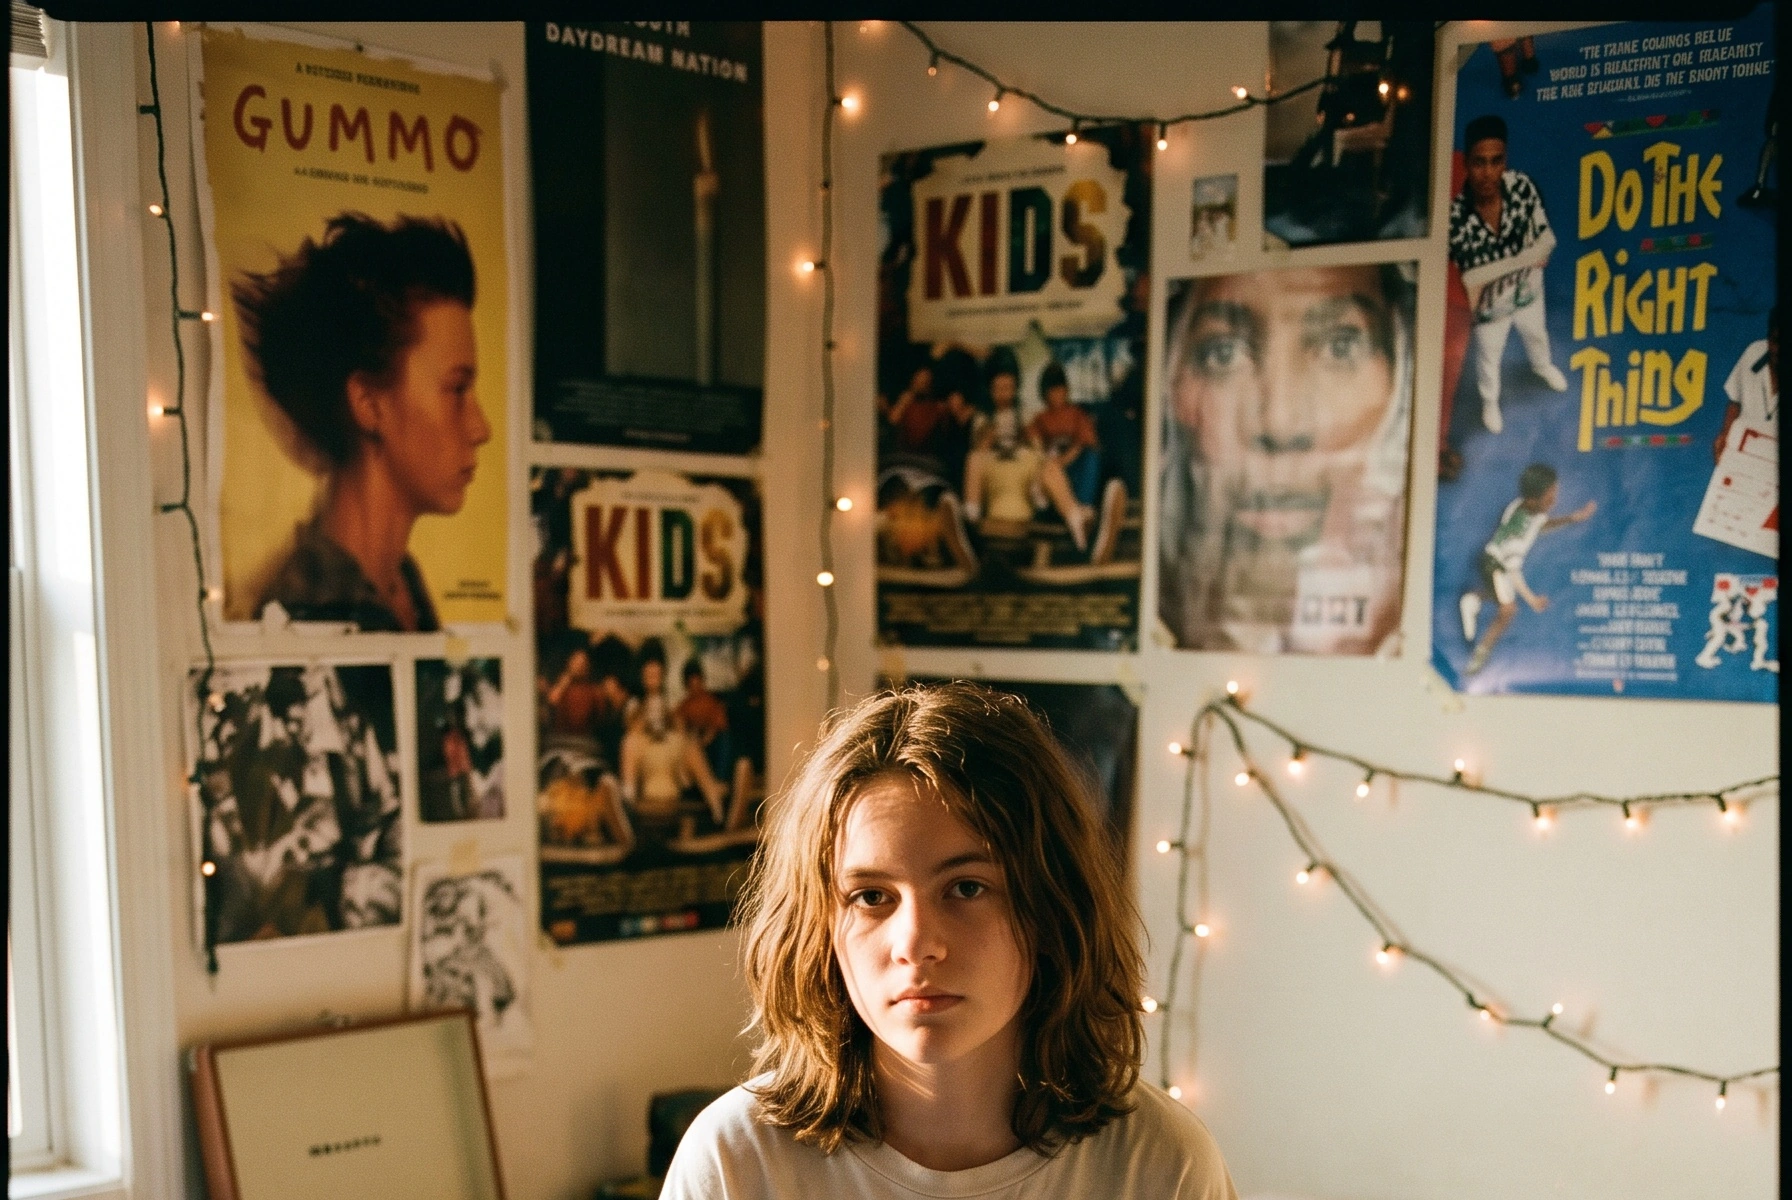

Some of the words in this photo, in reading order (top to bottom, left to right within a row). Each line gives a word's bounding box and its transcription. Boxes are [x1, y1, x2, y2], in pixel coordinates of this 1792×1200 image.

[545, 21, 664, 65] DAYDREAM
[670, 49, 748, 83] NATION
[1590, 62, 1601, 77] IS
[233, 84, 484, 173] GUMMO
[925, 178, 1108, 300] KIDS
[585, 506, 734, 603] KIDS
